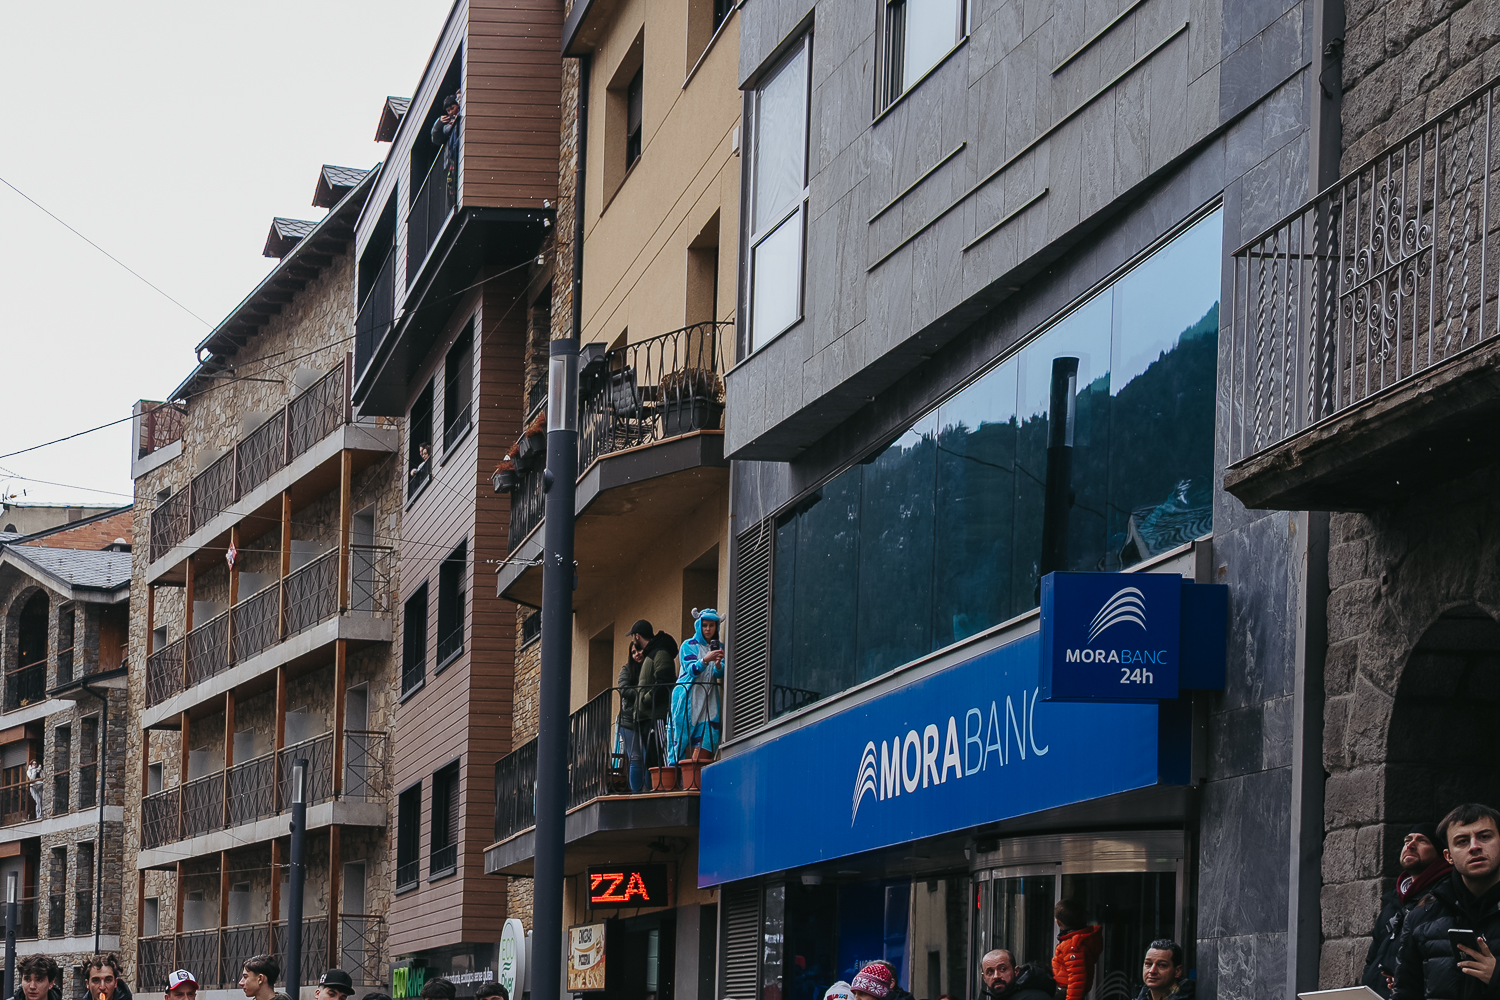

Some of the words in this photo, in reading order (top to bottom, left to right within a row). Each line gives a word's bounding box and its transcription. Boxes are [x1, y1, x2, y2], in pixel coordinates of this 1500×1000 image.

[1065, 648, 1168, 665] MORABANC
[1119, 667, 1154, 684] 24h
[879, 686, 1049, 801] MORABANC
[501, 937, 516, 961] ECO
